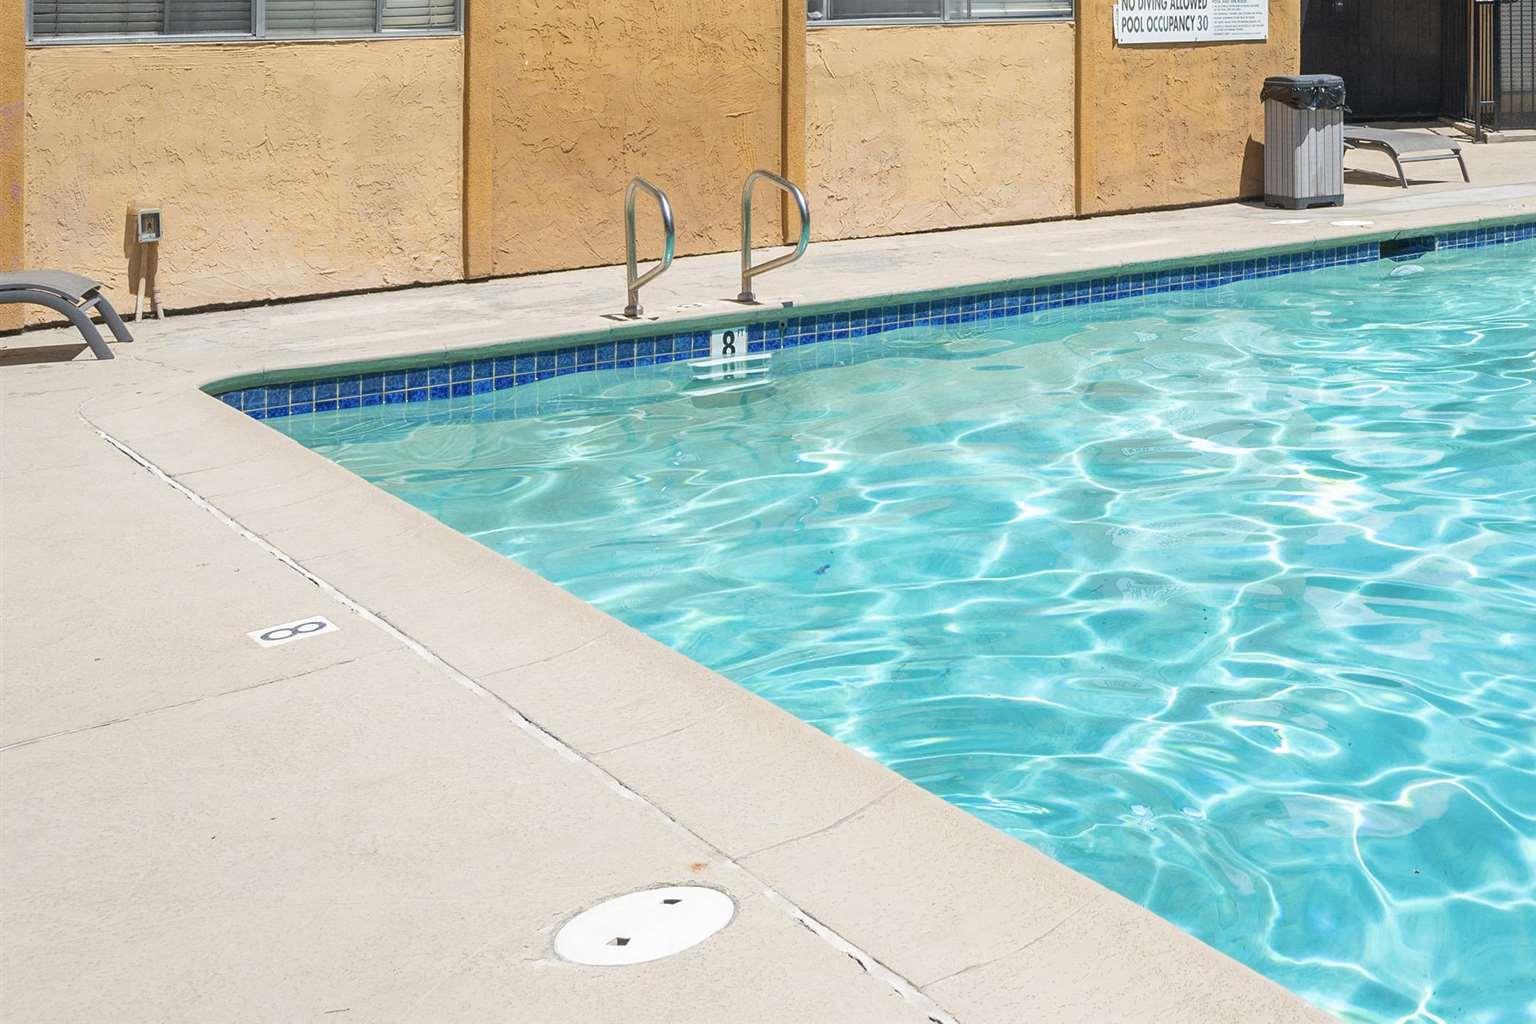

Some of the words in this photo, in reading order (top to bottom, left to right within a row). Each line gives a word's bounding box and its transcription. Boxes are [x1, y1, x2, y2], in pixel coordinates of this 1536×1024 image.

[1121, 16, 1144, 33] POOL
[1146, 15, 1196, 33] OCCUPANCY
[1196, 15, 1209, 32] 30
[722, 330, 736, 356] 8
[260, 621, 327, 641] 8
